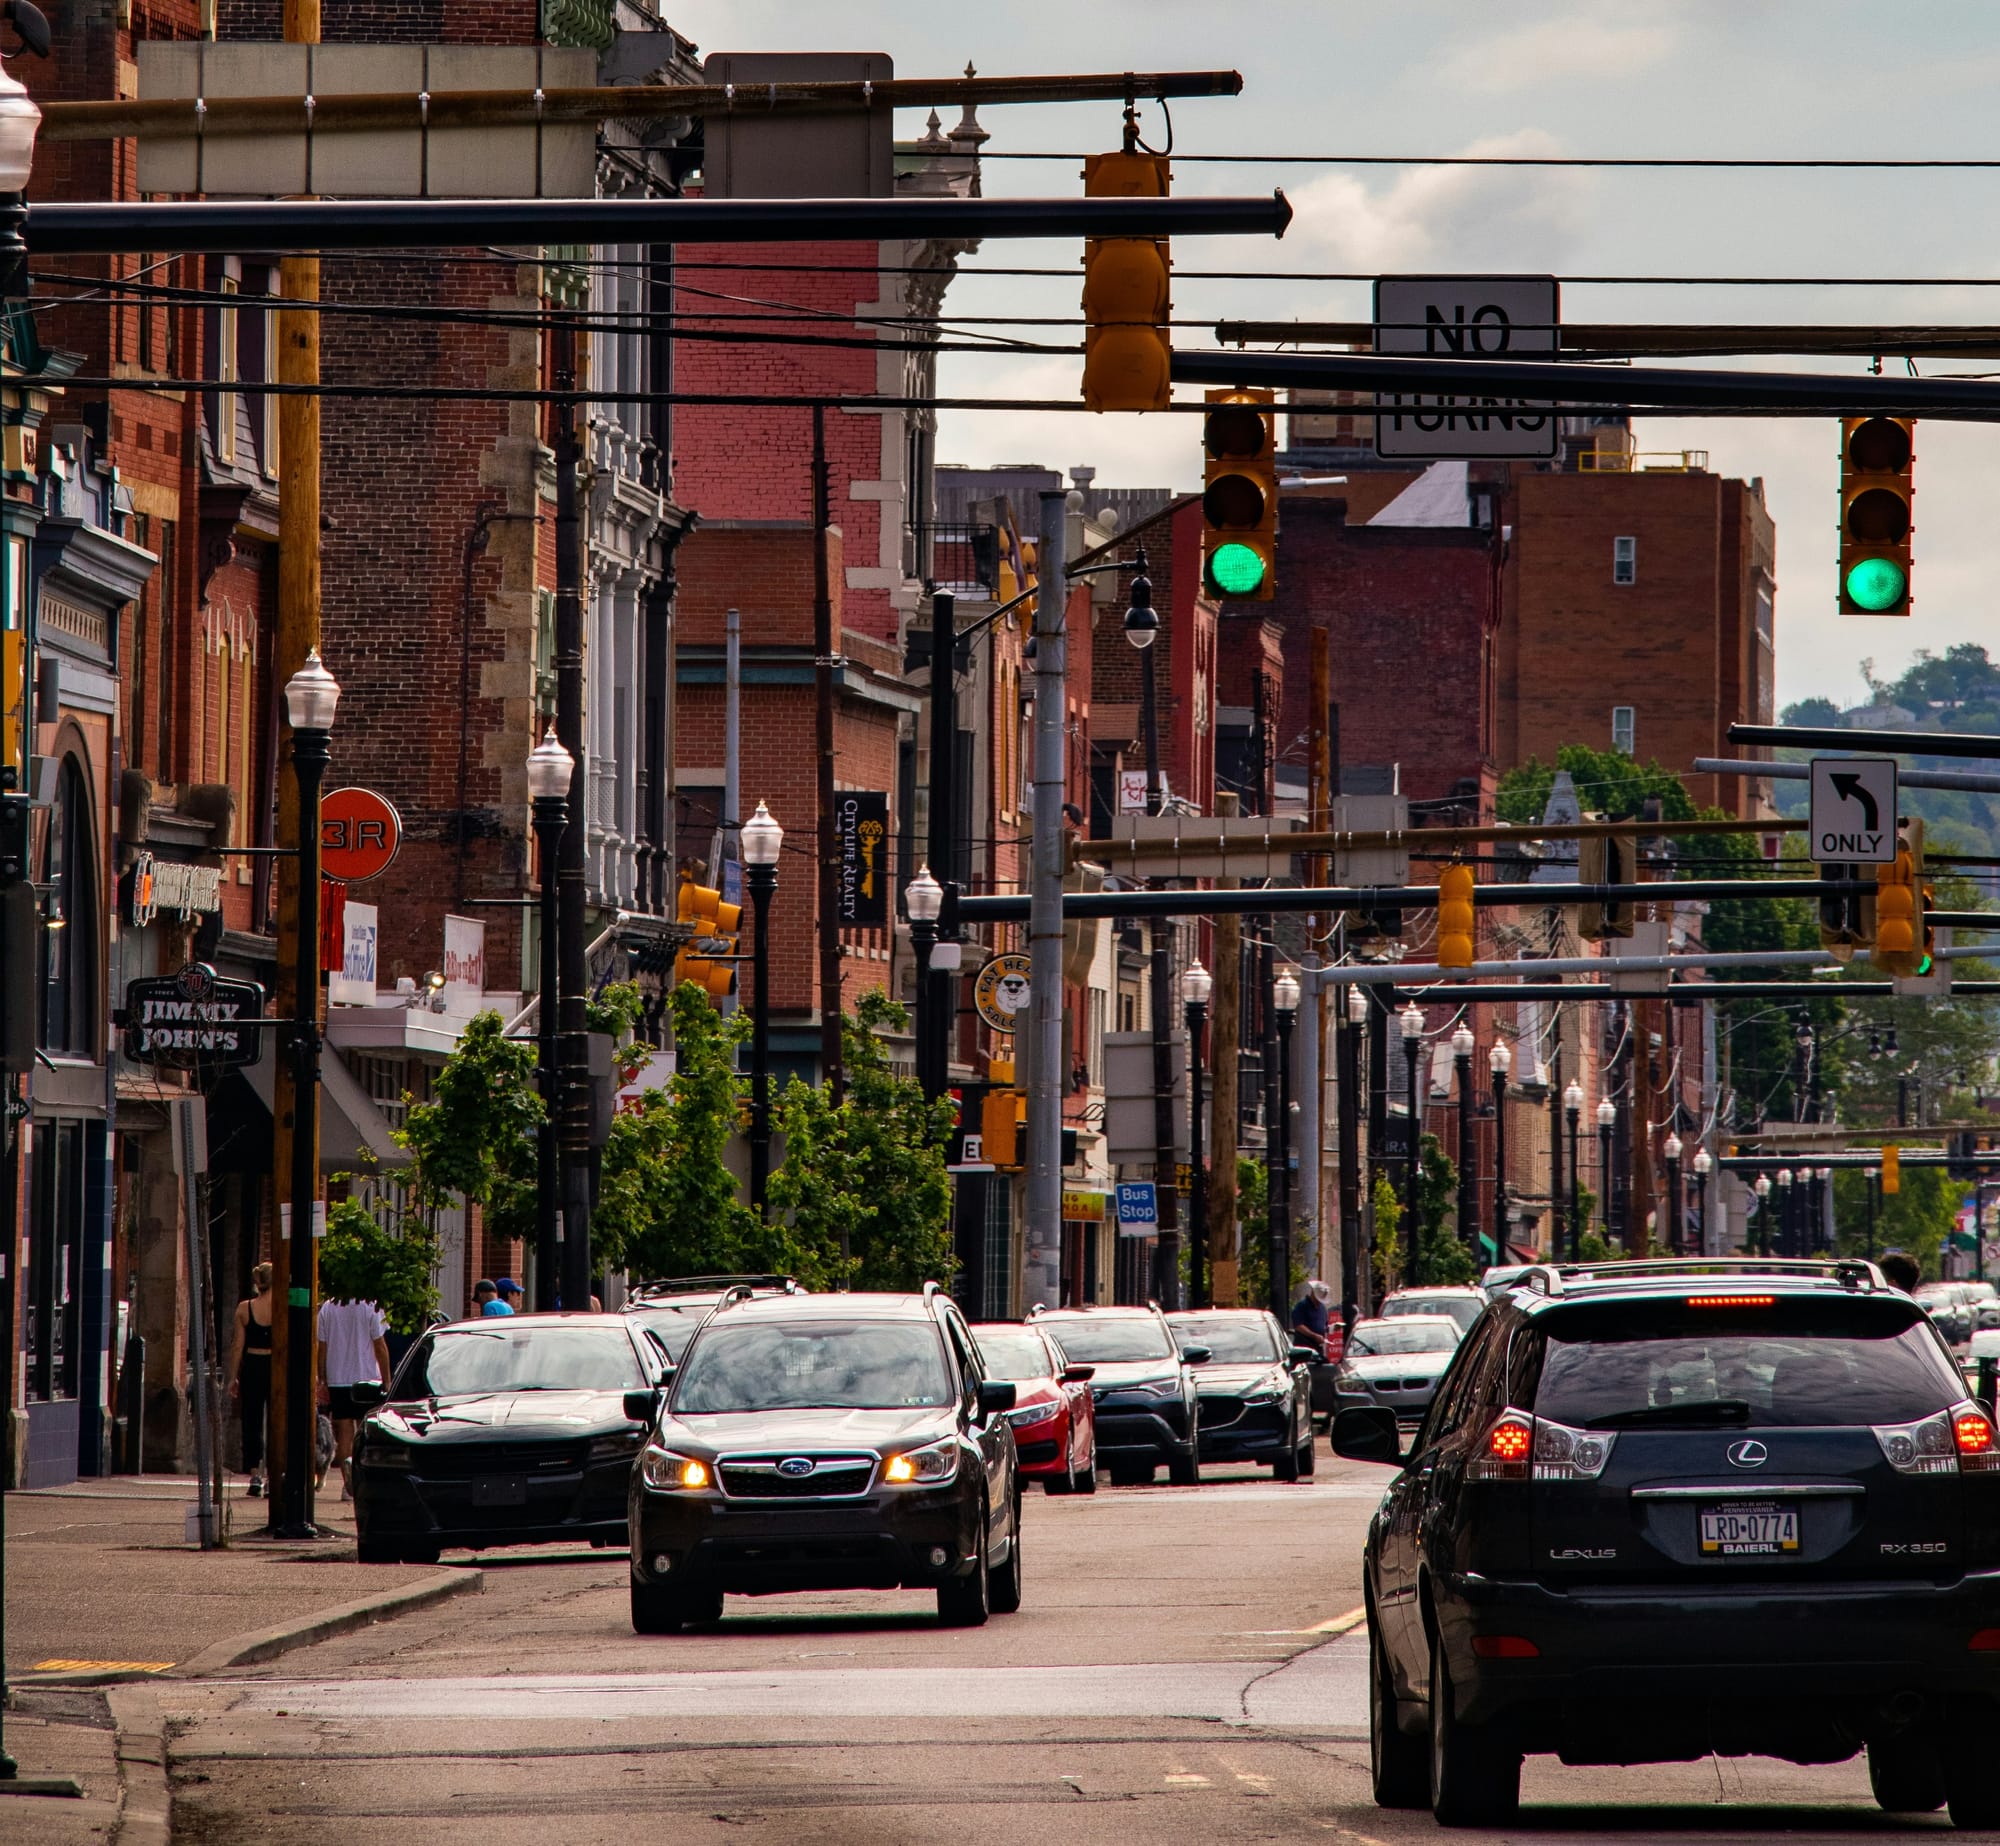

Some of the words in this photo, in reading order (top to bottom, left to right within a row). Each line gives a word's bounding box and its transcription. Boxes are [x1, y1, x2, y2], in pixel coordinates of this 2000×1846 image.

[1425, 304, 1511, 353] NO
[844, 799, 858, 861] CITYLIFE
[1821, 832, 1884, 854] ONLY
[843, 864, 858, 919] REALTY
[980, 966, 999, 993] FAT
[142, 1000, 240, 1023] JIMMY
[140, 1028, 239, 1052] JOHN'S
[1121, 1187, 1149, 1201] Bus
[1120, 1204, 1154, 1220] Stop
[1550, 1549, 1617, 1559] LEXUS
[1723, 1543, 1778, 1554] BAIERL
[1880, 1544, 1908, 1554] RX
[1909, 1542, 1947, 1553] 350
